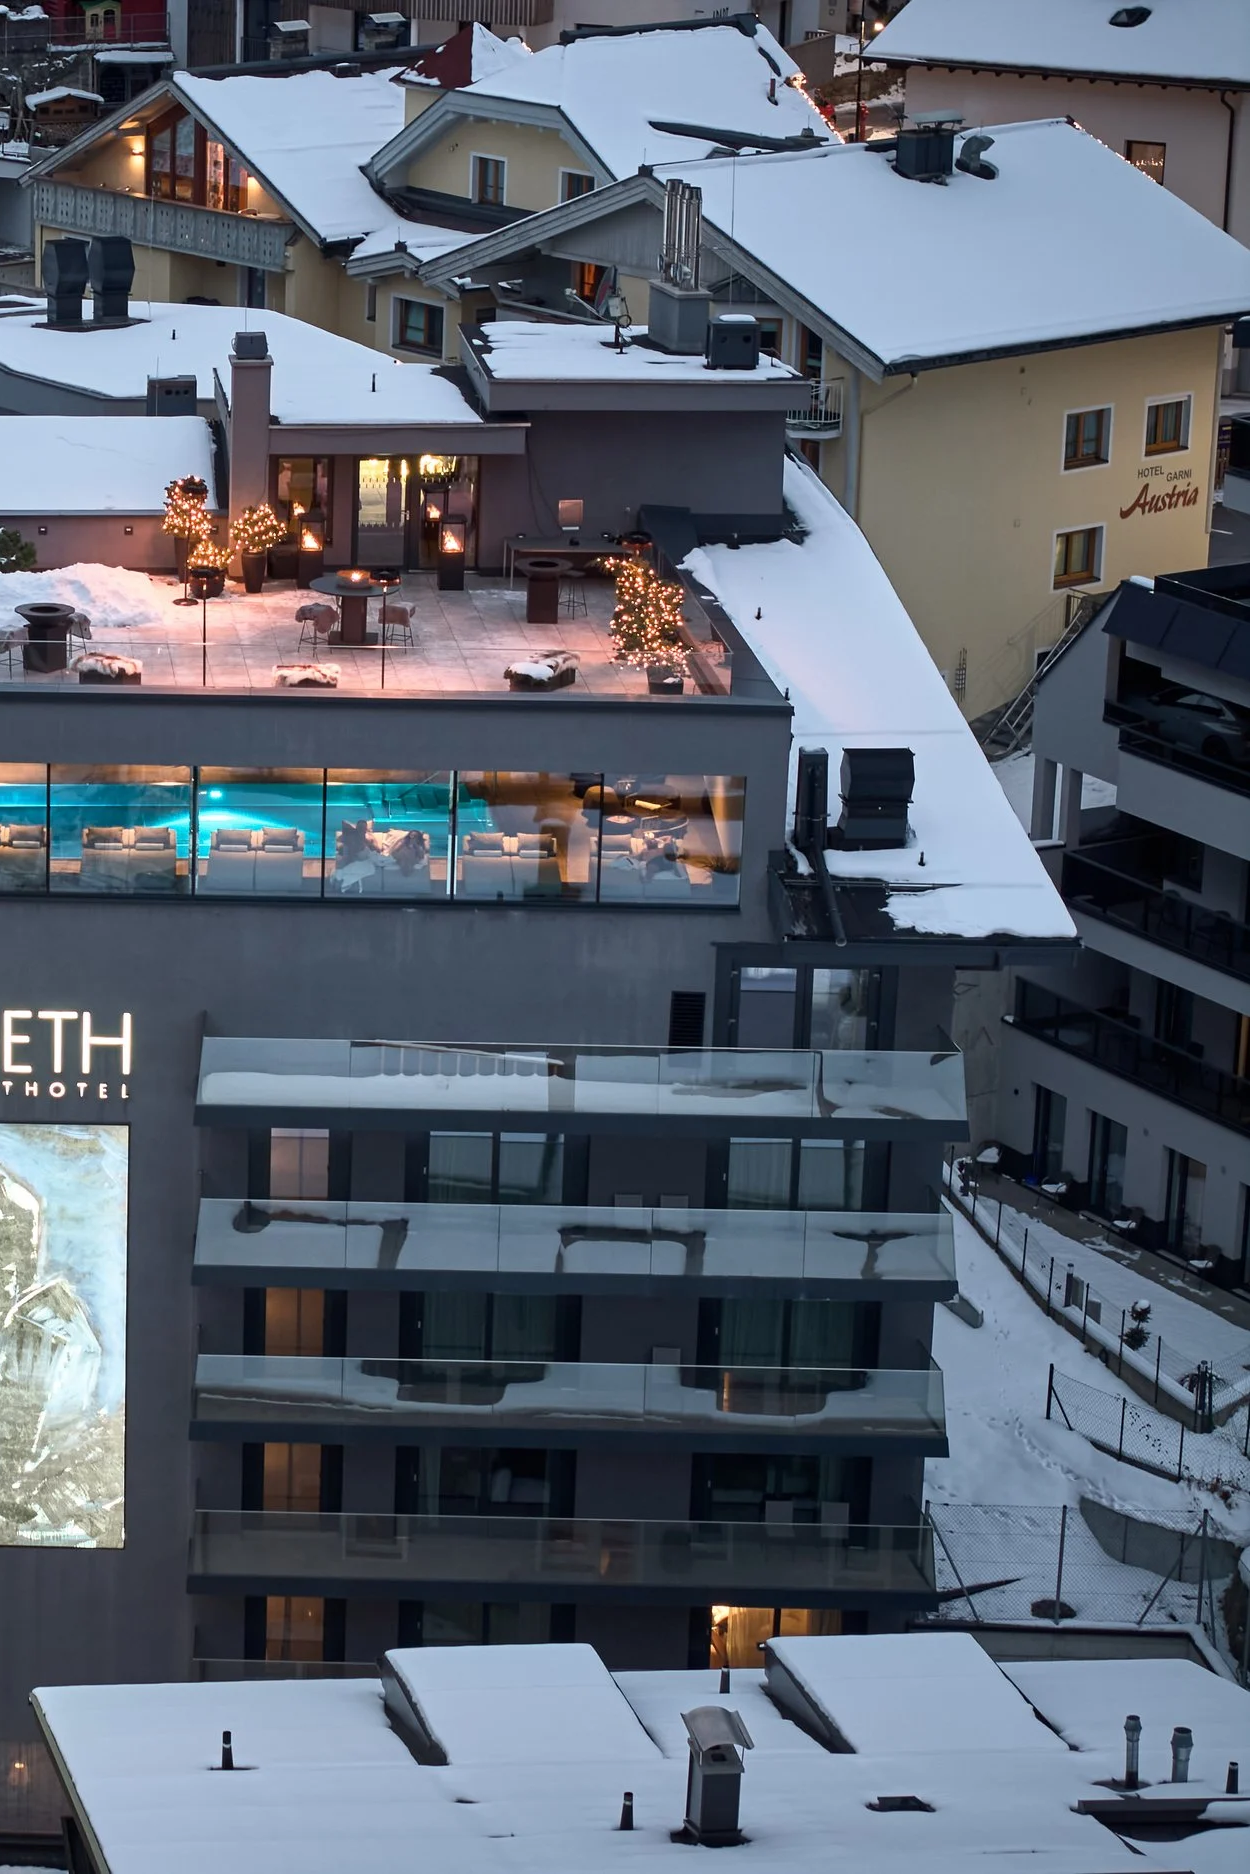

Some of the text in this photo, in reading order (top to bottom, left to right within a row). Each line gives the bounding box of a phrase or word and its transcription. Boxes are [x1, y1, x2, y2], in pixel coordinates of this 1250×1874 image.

[1137, 465, 1192, 482] HOTEL GARNI
[1119, 482, 1199, 520] Austria
